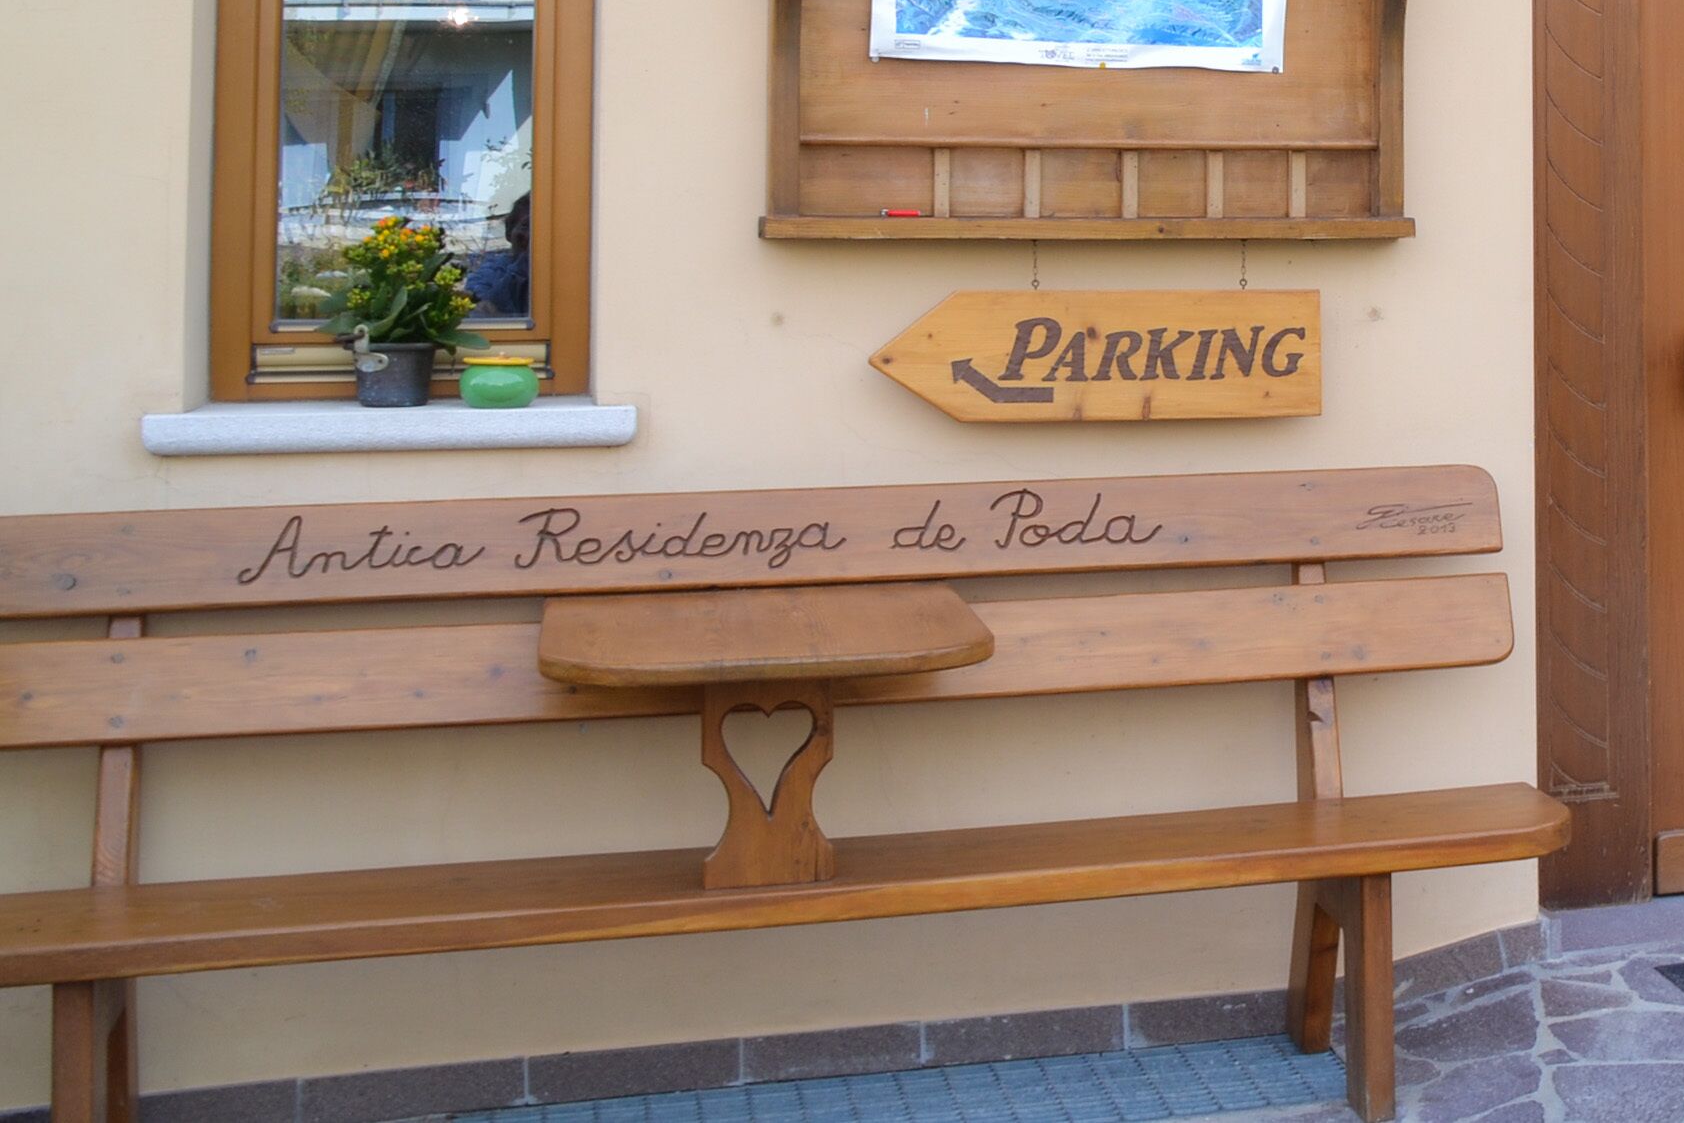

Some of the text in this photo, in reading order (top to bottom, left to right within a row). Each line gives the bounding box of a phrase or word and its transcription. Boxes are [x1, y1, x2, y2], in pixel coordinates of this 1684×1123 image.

[998, 317, 1306, 382] PARKING
[237, 488, 1164, 586] Antica Residenza de Poda
[1417, 522, 1456, 536] 2013
